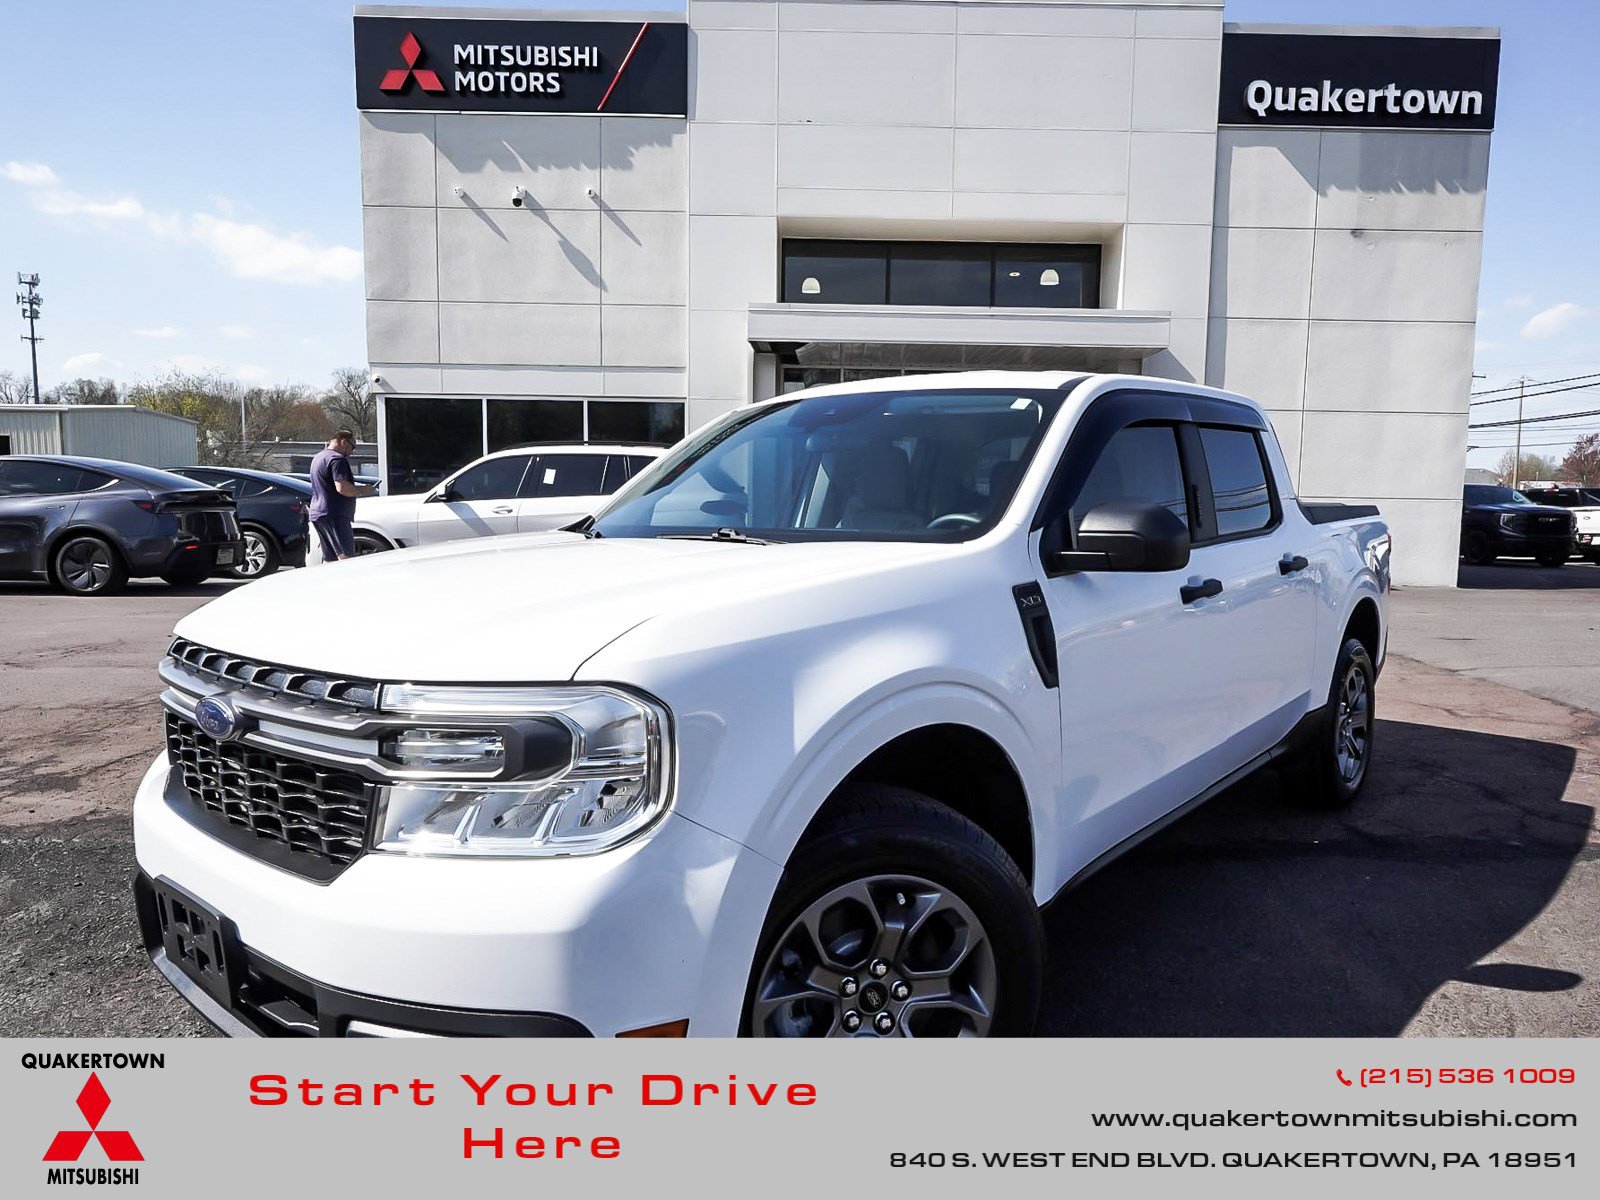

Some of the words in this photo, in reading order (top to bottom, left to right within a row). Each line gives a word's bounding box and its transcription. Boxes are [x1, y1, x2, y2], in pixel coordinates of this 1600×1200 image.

[453, 44, 598, 68] MITSUBISHI
[454, 71, 561, 93] MOTORS
[1246, 79, 1483, 117] Quakertown
